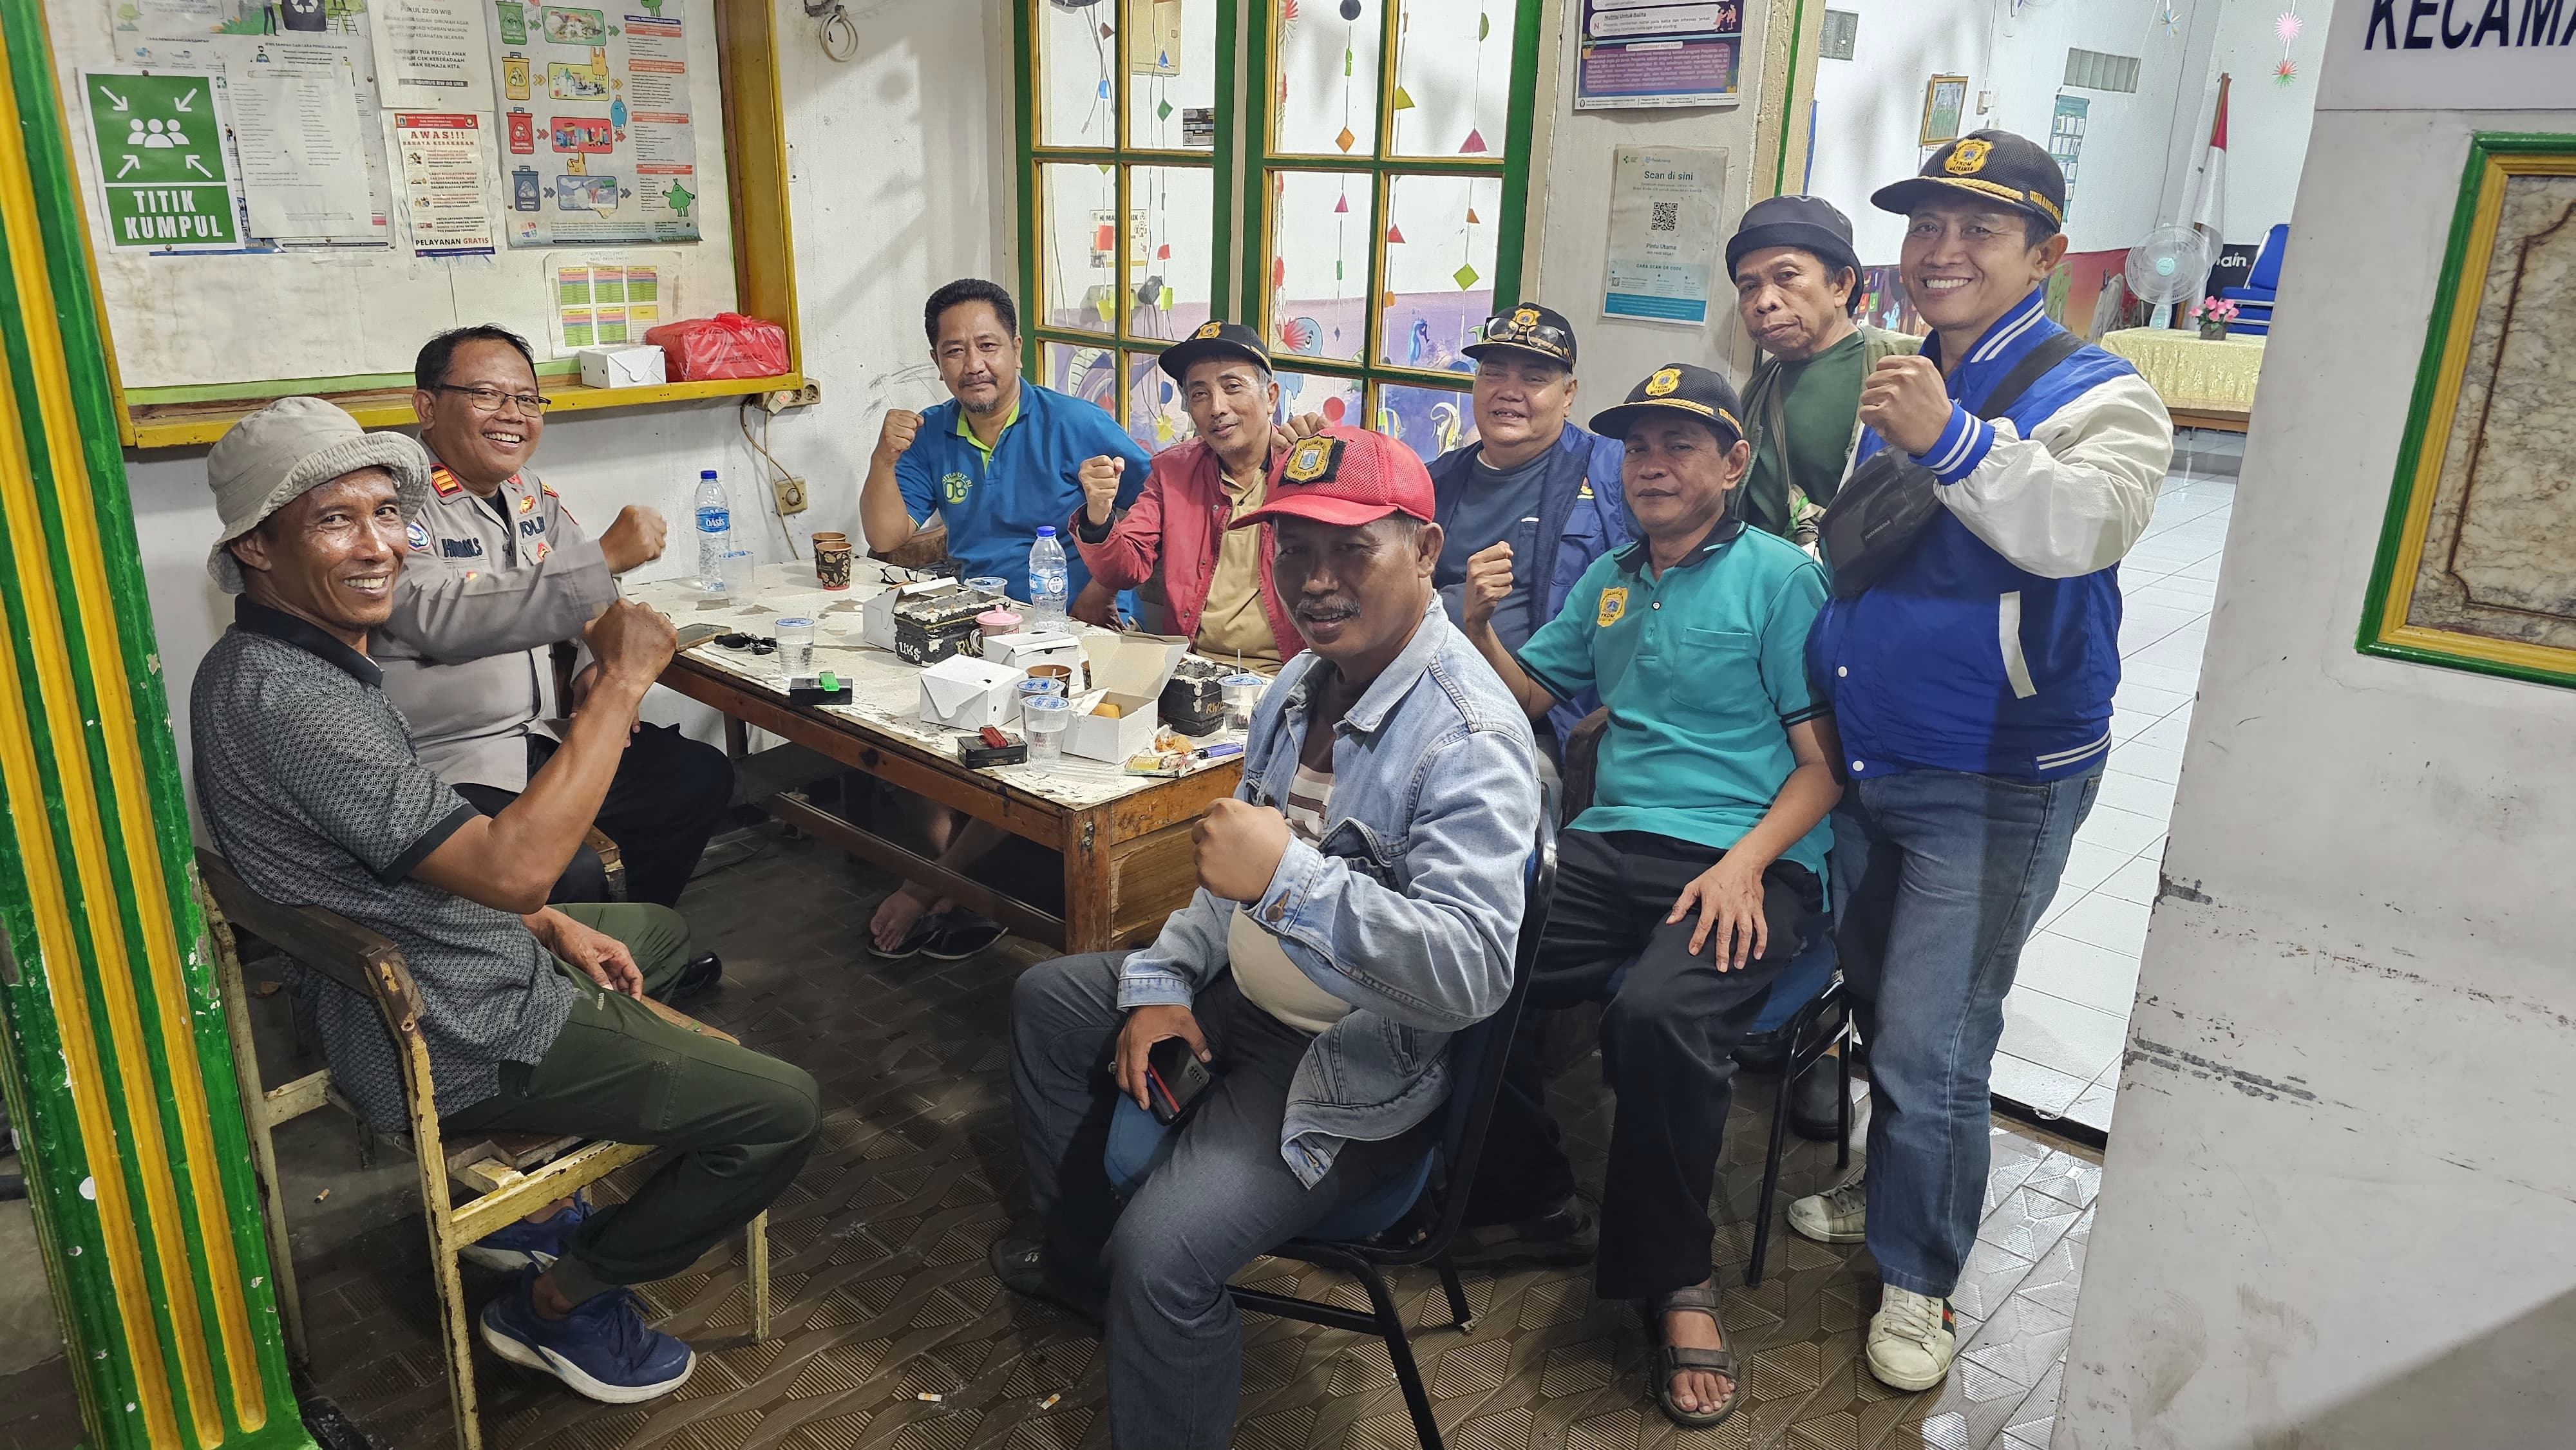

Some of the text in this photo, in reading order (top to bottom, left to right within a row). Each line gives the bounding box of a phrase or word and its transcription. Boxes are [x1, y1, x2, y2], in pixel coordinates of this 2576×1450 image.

[1644, 171, 1693, 180] Scan di sini
[133, 191, 196, 212] TITIK
[124, 216, 223, 239] KUMPUL
[2217, 252, 2247, 267] ain
[898, 642, 921, 661] UKS
